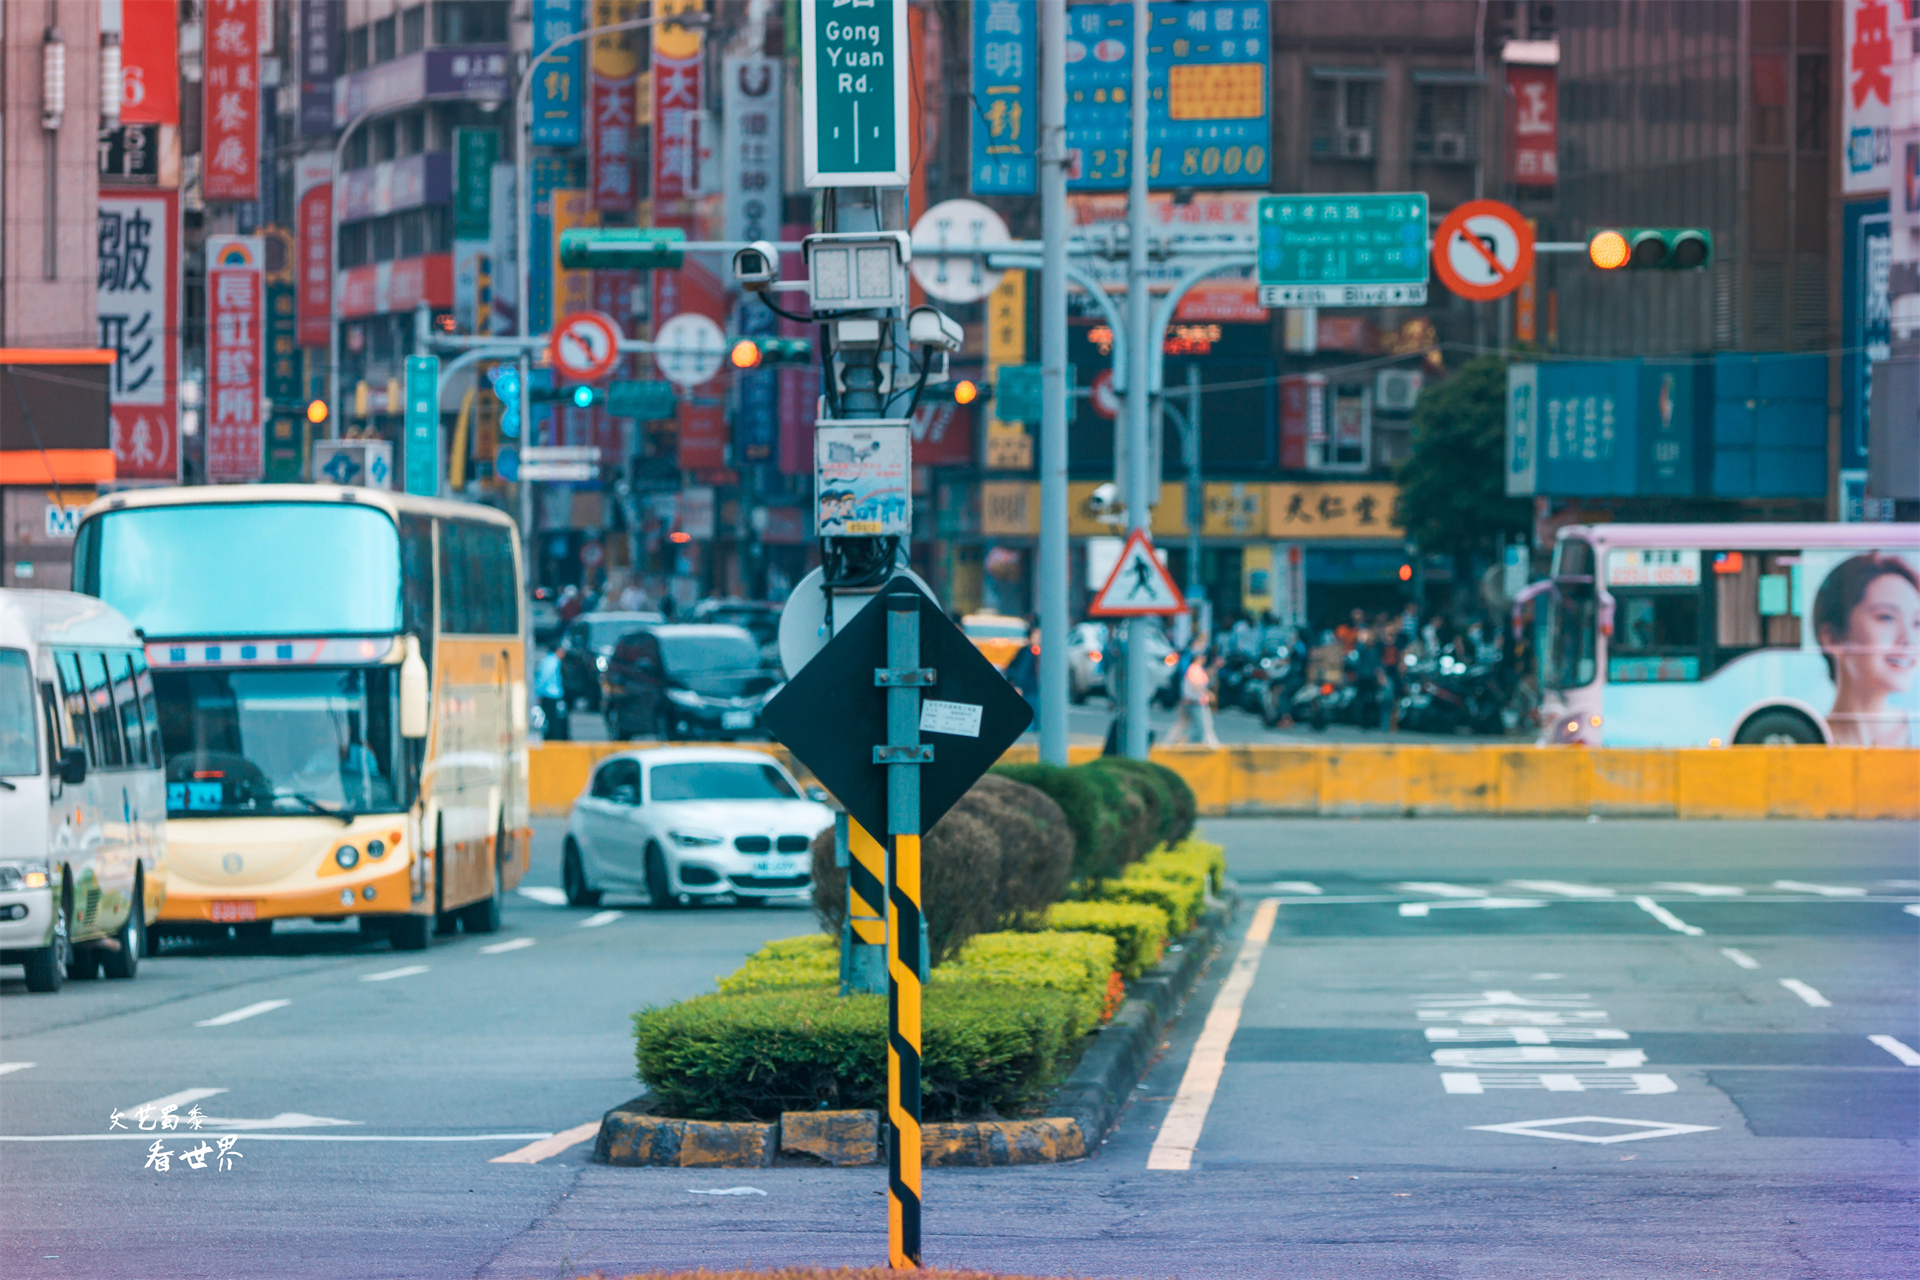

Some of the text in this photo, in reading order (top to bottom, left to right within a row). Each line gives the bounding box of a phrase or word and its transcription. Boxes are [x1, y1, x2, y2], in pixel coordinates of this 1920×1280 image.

[826, 20, 880, 47] Gong
[826, 46, 884, 68] Yuan
[838, 72, 874, 94] Rd.
[1180, 144, 1266, 176] 8000
[216, 275, 254, 424] 長虹診所
